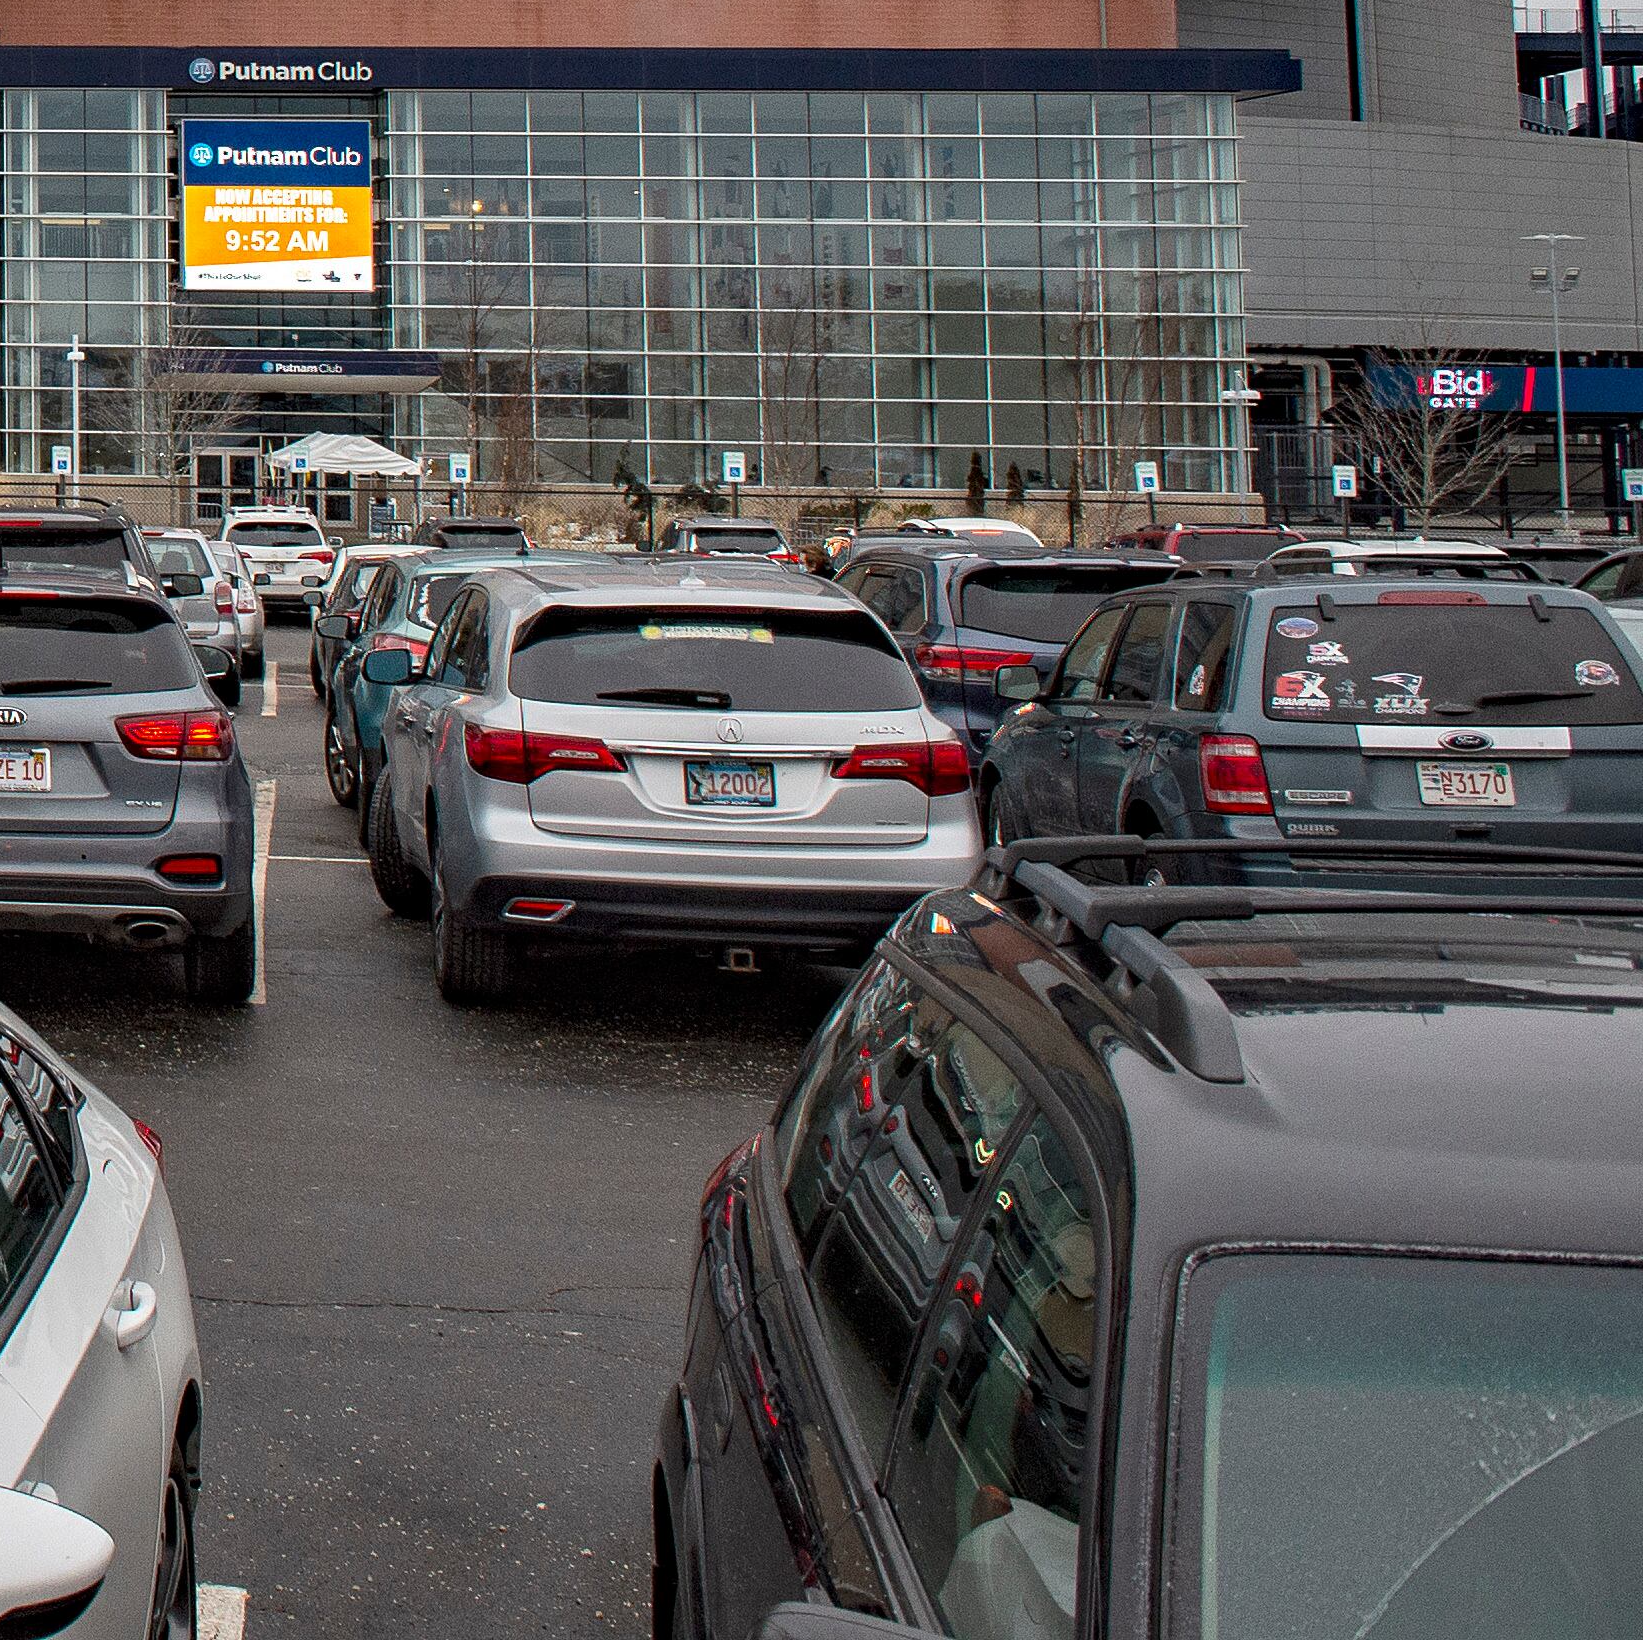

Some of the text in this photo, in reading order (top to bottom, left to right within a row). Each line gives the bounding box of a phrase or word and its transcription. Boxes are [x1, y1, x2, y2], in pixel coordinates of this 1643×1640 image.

[219, 61, 373, 82] Putnam Club
[217, 146, 362, 166] Putnam Club
[215, 188, 333, 206] NOW ACCEPTING
[204, 206, 314, 223] APPOINTMENTS
[225, 230, 329, 252] 9:52 AM
[275, 362, 343, 373] Putnam Club
[1429, 398, 1478, 408] GATE
[1272, 697, 1331, 708] CHAMPIONS
[860, 725, 905, 735] MDX
[22, 760, 44, 780] 10
[708, 771, 770, 796] 12002
[1453, 772, 1507, 795] 3170
[1287, 823, 1336, 832] QUIRK
